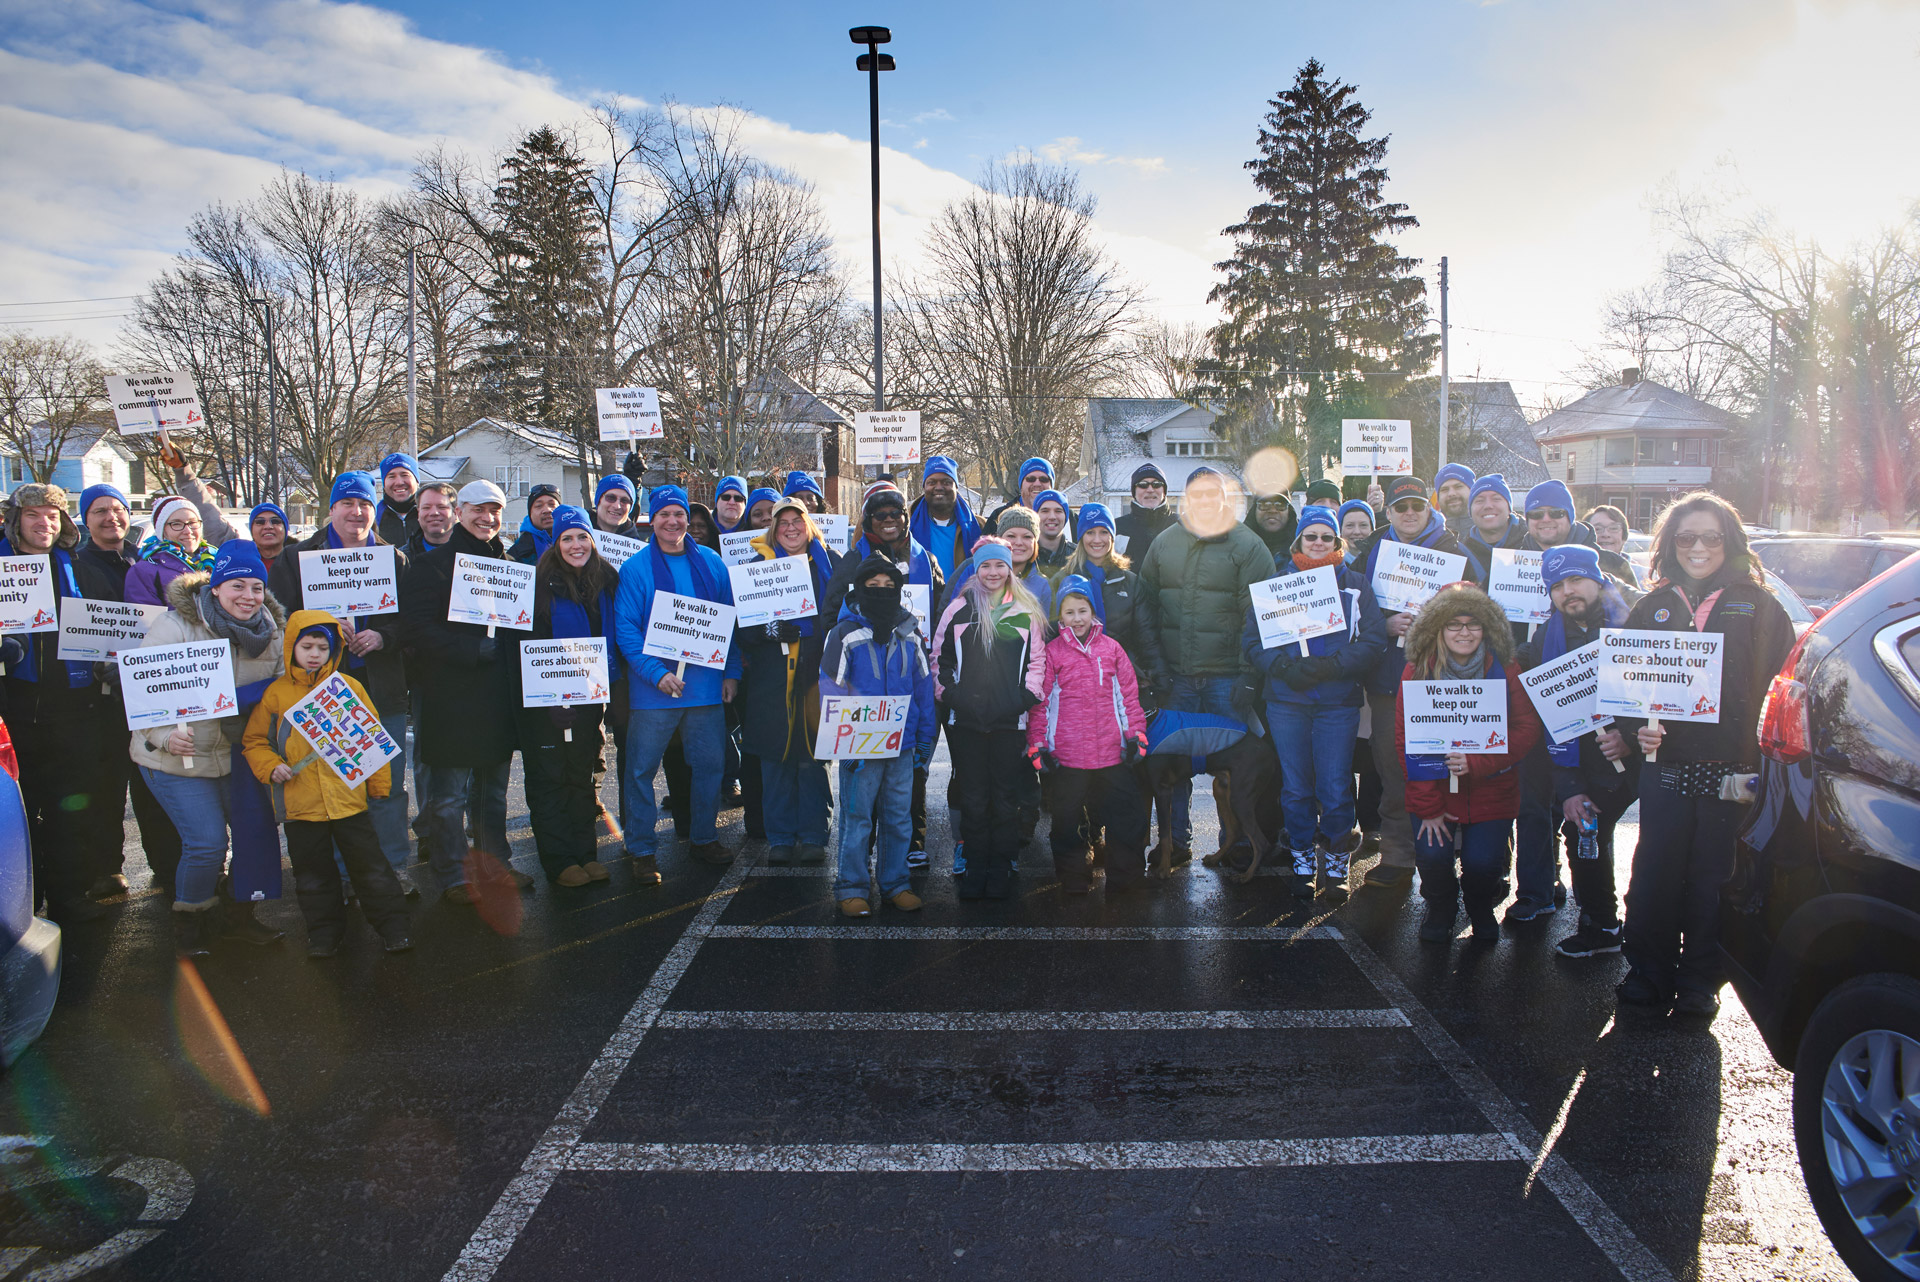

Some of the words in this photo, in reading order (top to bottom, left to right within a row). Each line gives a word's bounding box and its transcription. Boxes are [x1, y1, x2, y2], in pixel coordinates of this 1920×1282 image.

[125, 378, 140, 386] We
[142, 377, 163, 385] walk
[134, 389, 155, 397] keep
[119, 399, 167, 410] community
[170, 397, 194, 405] warm
[615, 402, 631, 410] keep
[602, 411, 638, 419] community
[874, 426, 889, 434] keep
[860, 435, 896, 444] community
[1362, 434, 1379, 443] keep
[1346, 444, 1386, 454] community
[613, 539, 631, 548] walk
[603, 545, 621, 556] keep
[730, 548, 748, 556] cares
[1399, 548, 1411, 558] We
[1414, 553, 1434, 564] walk
[1436, 557, 1445, 566] to
[321, 554, 336, 564] We
[339, 552, 361, 563] walk
[364, 552, 373, 560] to
[1514, 555, 1528, 565] We
[3, 562, 44, 573] Energy
[328, 567, 351, 577] keep
[459, 558, 504, 573] Consumers
[506, 565, 532, 580] Energy
[747, 568, 760, 576] We
[762, 564, 781, 573] walk
[783, 562, 791, 570] to
[1399, 561, 1420, 575] keep
[1422, 568, 1438, 577] our
[18, 578, 38, 586] our
[463, 574, 485, 583] cares
[488, 576, 512, 587] about
[513, 581, 526, 589] our
[754, 577, 773, 587] keep
[1378, 572, 1426, 590] community
[1428, 582, 1441, 590] wa
[1518, 569, 1540, 582] keep
[308, 579, 361, 591] community
[364, 578, 391, 586] warm
[1269, 583, 1283, 592] We
[1284, 577, 1305, 589] walk
[0, 591, 28, 604] unity
[471, 587, 518, 603] community
[739, 587, 784, 602] community
[785, 584, 809, 593] warm
[1277, 593, 1297, 604] keep
[1300, 589, 1313, 598] our
[86, 603, 102, 612] We
[105, 607, 130, 615] walk
[133, 608, 144, 616] to
[673, 599, 685, 609] We
[688, 604, 707, 614] walk
[710, 607, 718, 616] to
[1261, 603, 1308, 621] community
[1310, 597, 1336, 608] warm
[91, 615, 117, 627] keep
[675, 612, 694, 625] keep
[697, 618, 711, 627] our
[66, 627, 127, 640] community
[654, 622, 701, 639] community
[703, 631, 726, 643] warm
[524, 645, 571, 654] Consumers
[574, 643, 603, 653] Energy
[1605, 635, 1671, 649] Consumers
[1674, 638, 1717, 654] Energy
[123, 650, 184, 666] Consumers
[187, 646, 225, 658] Energy
[531, 658, 553, 666] cares
[556, 656, 581, 665] about
[584, 656, 598, 664] our
[1612, 654, 1643, 664] cares
[1646, 653, 1683, 666] about
[1686, 658, 1708, 668] our
[134, 668, 162, 680] cares
[165, 662, 198, 676] about
[201, 662, 219, 671] our
[541, 668, 590, 678] community
[1526, 659, 1578, 687] Consumers
[1578, 649, 1599, 664] Ene
[147, 677, 210, 693] community
[1540, 682, 1565, 698] cares
[1566, 667, 1596, 687] about
[1623, 671, 1694, 687] community
[1426, 685, 1442, 695] We
[1444, 685, 1469, 694] walk
[1472, 685, 1482, 694] to
[1557, 680, 1598, 707] commun
[825, 699, 905, 722] Fratelli's
[1433, 699, 1457, 711] keep
[314, 689, 373, 751] HEALTH
[327, 677, 396, 755] SPECTRUM
[1410, 713, 1468, 725] community
[1471, 714, 1501, 722] warm
[304, 702, 363, 766] MEDICAL
[293, 711, 363, 781] GENETICS
